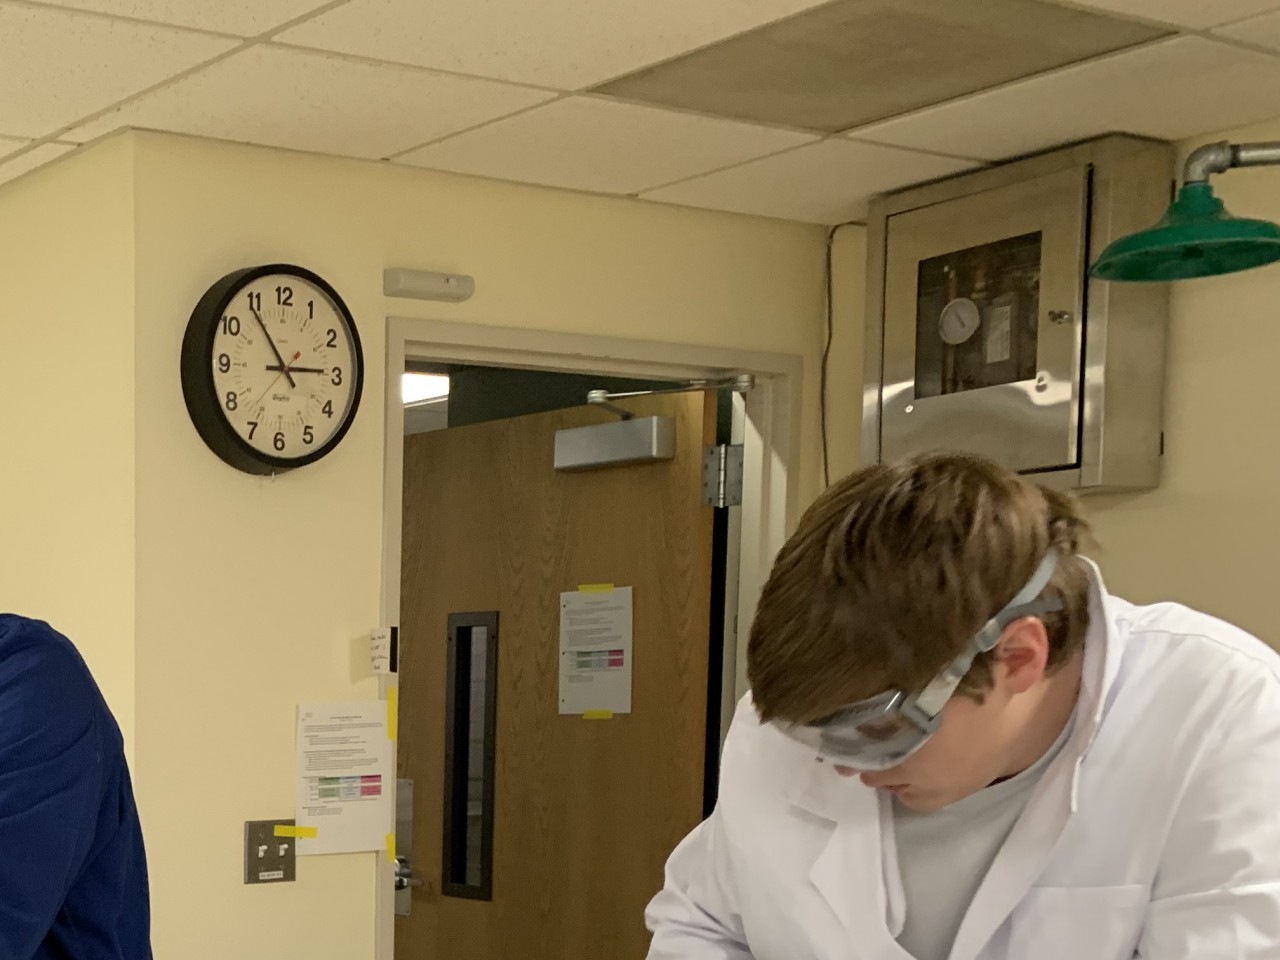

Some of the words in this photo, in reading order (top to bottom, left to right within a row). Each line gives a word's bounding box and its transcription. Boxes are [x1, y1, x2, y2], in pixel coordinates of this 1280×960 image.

[275, 286, 293, 307] 12
[307, 300, 314, 319] 1
[221, 315, 240, 336] 10
[326, 328, 337, 348] 2
[218, 353, 231, 374] 9
[331, 367, 343, 386] 3
[225, 391, 238, 411] 8
[322, 400, 334, 418] 4
[247, 421, 259, 440] 7
[302, 426, 314, 444] 5
[273, 432, 285, 451] 6
